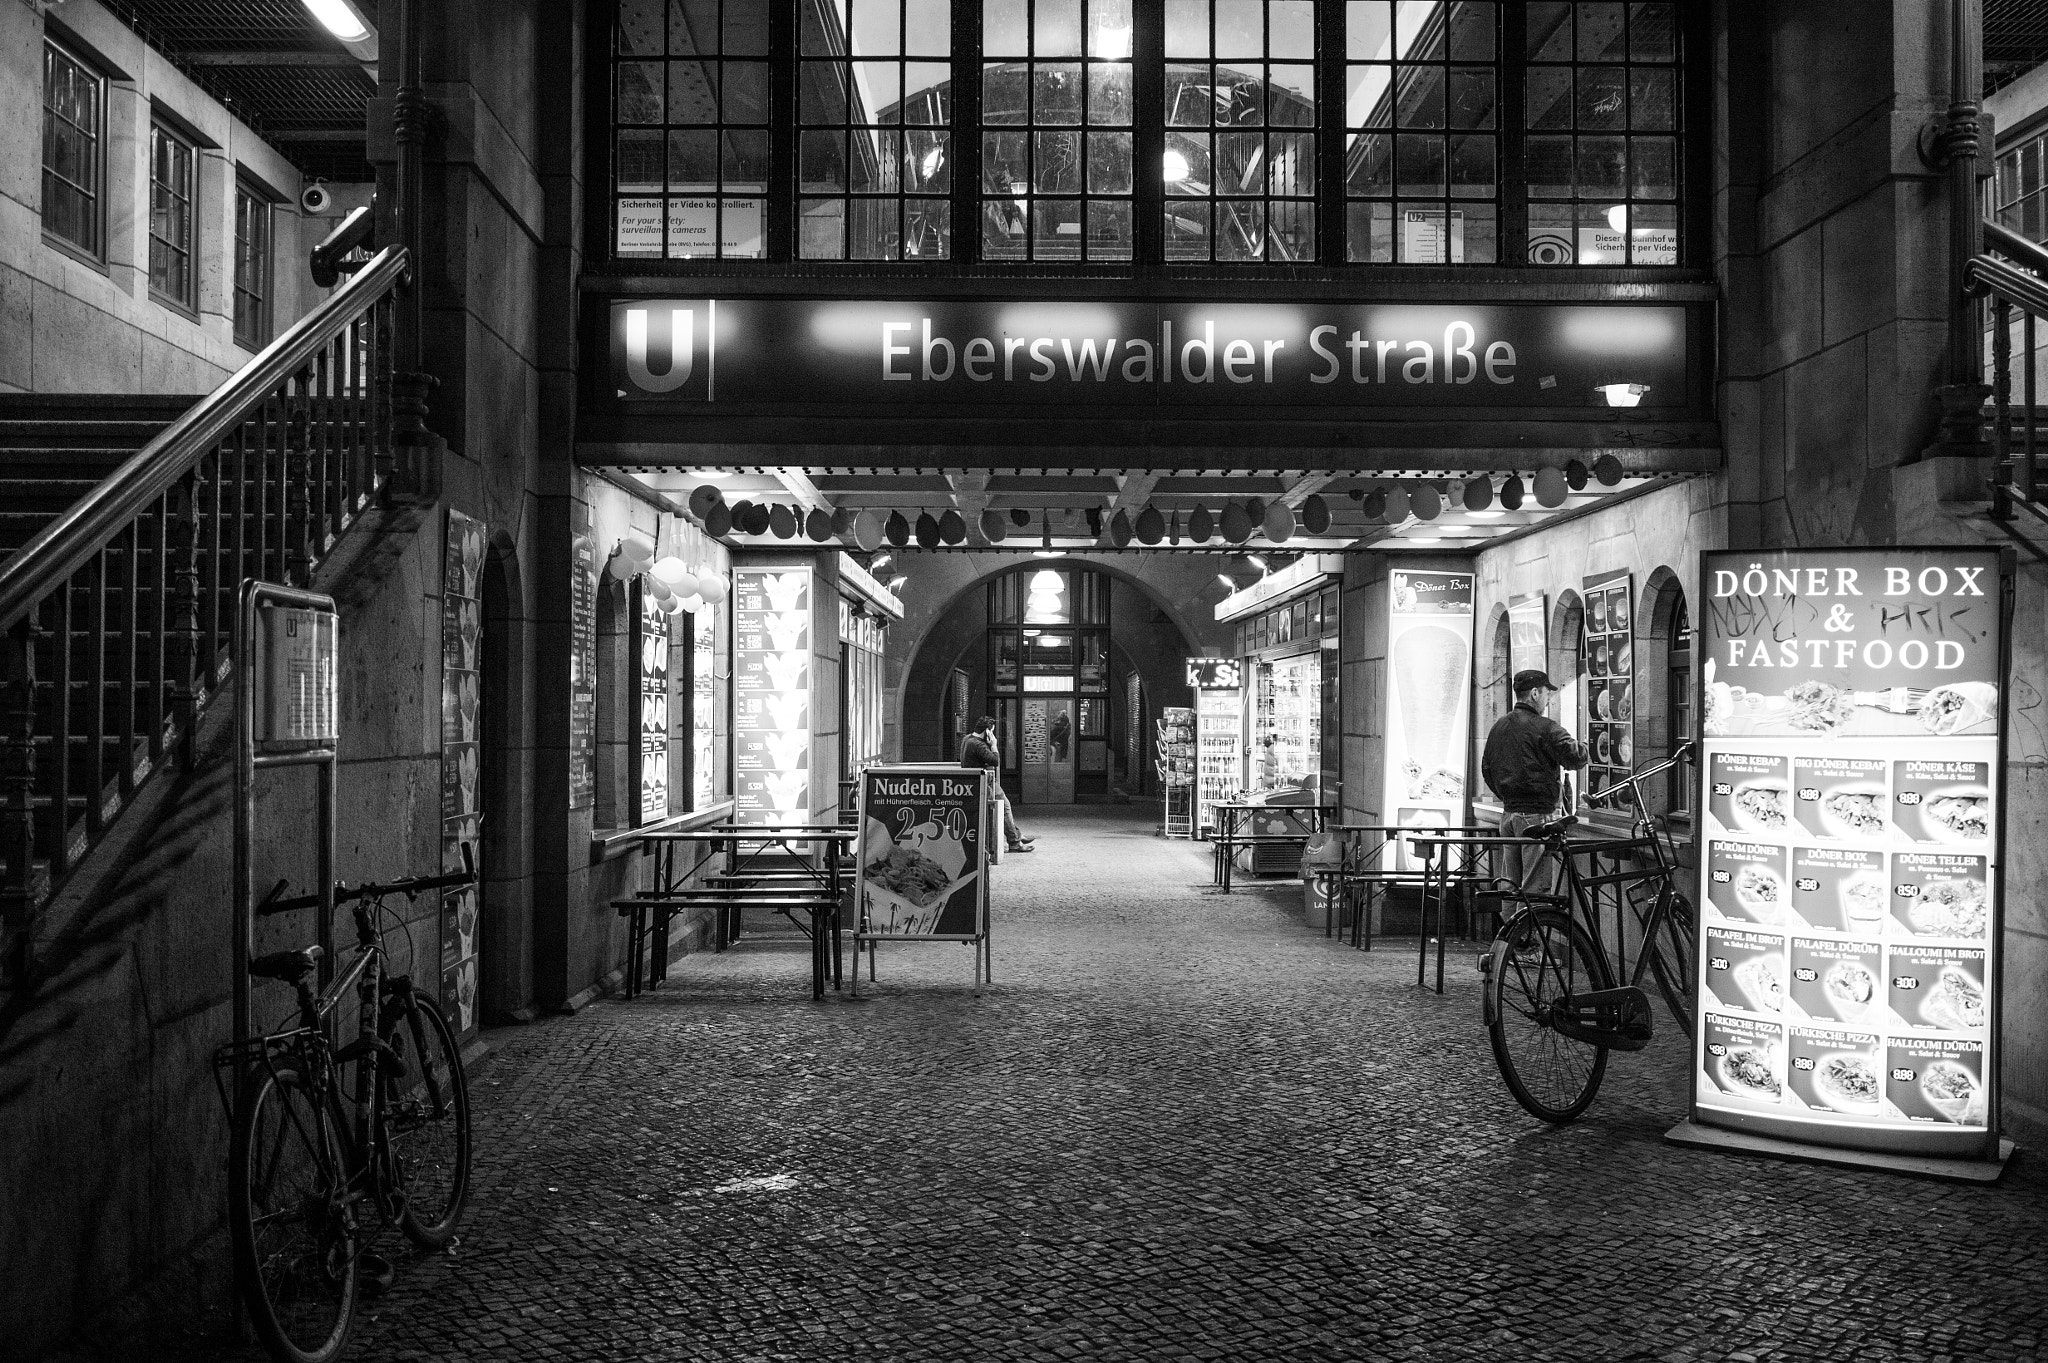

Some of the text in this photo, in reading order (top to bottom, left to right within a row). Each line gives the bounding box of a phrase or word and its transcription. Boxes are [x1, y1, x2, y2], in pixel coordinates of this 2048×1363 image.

[622, 200, 662, 208] Sicherheit
[680, 200, 704, 208] Video
[706, 200, 755, 208] kotrolliert.
[622, 216, 686, 226] For your sfety:
[1410, 213, 1424, 222] U2
[622, 226, 670, 234] surveillan
[1596, 234, 1621, 242] Dieser
[1638, 245, 1652, 253] per
[1654, 244, 1677, 252] Video
[626, 309, 1518, 393] U Eberswalder Straße
[1449, 579, 1470, 590] Box
[1714, 563, 1985, 598] DÖNER BOX
[1824, 603, 1856, 633] &
[1727, 639, 1966, 670] FASTFOOD
[1717, 754, 1781, 766] DÖNER KEBAP
[1795, 758, 1886, 770] BIG DÖNER KEBAP
[1906, 761, 1976, 772] DÖNER KÄSE
[874, 778, 974, 796] Nudeln Box
[1714, 842, 1779, 856] DÜRÜM DÖNER
[1808, 848, 1868, 862] DÖNER BOX
[1900, 854, 1978, 866] DÖNER TELLER
[1708, 928, 1784, 945] FALAFEL IM BROT
[1794, 938, 1878, 954] FALAFEL DÜRÜM
[1890, 946, 1985, 959] HALLOUMI IM BROT
[1706, 1014, 1782, 1034] TÜRKISCHE PIZZA
[1847, 1033, 1876, 1044] PIZZA
[1888, 1038, 1982, 1052] HALLOUMI DÜRÜM
